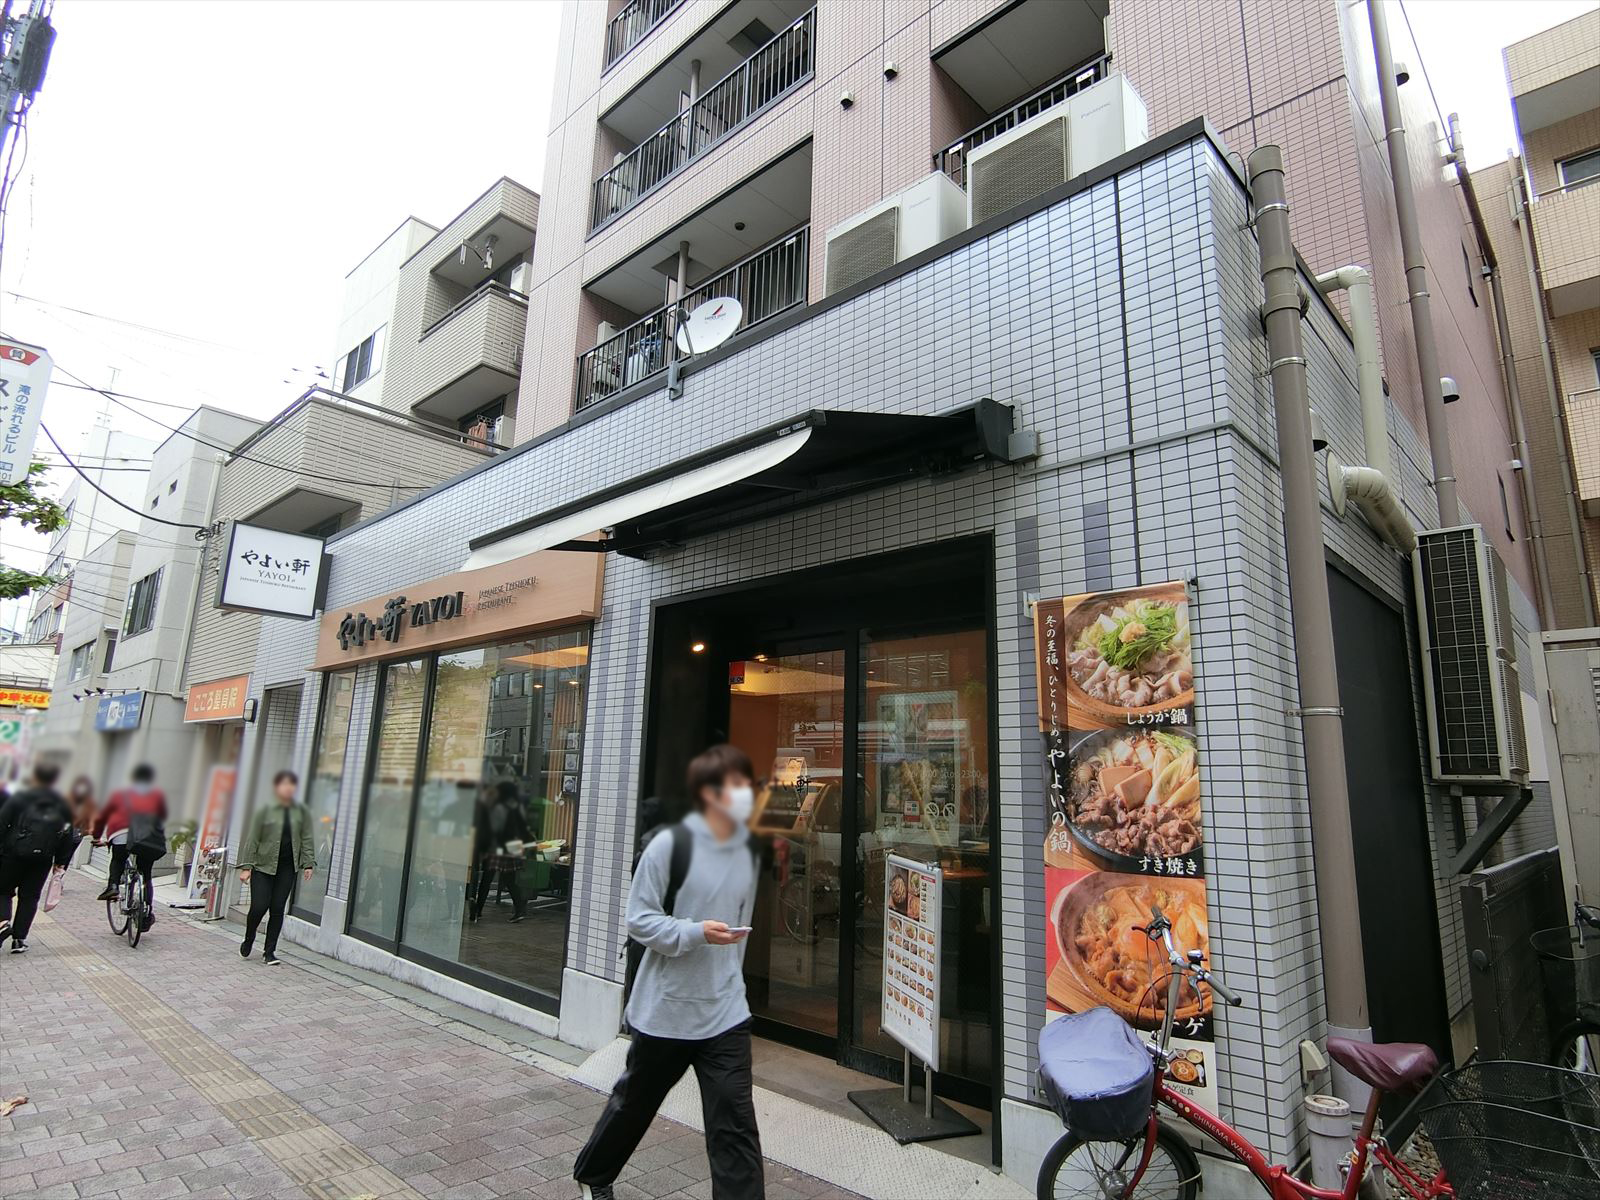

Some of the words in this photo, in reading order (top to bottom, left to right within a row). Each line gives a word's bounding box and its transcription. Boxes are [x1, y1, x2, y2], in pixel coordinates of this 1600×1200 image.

[3, 383, 32, 454] 滝の流れるビル
[241, 549, 311, 576] やよい軒
[258, 569, 291, 583] YAYOI
[337, 596, 407, 651] やよい軒
[409, 590, 465, 628] YAYOI
[1126, 708, 1188, 726] しょうが鍋
[1047, 748, 1072, 854] やよいの鍋
[1138, 857, 1198, 876] すき焼き
[1193, 1112, 1229, 1144] CHINEMA
[1231, 1140, 1253, 1161] WALK
